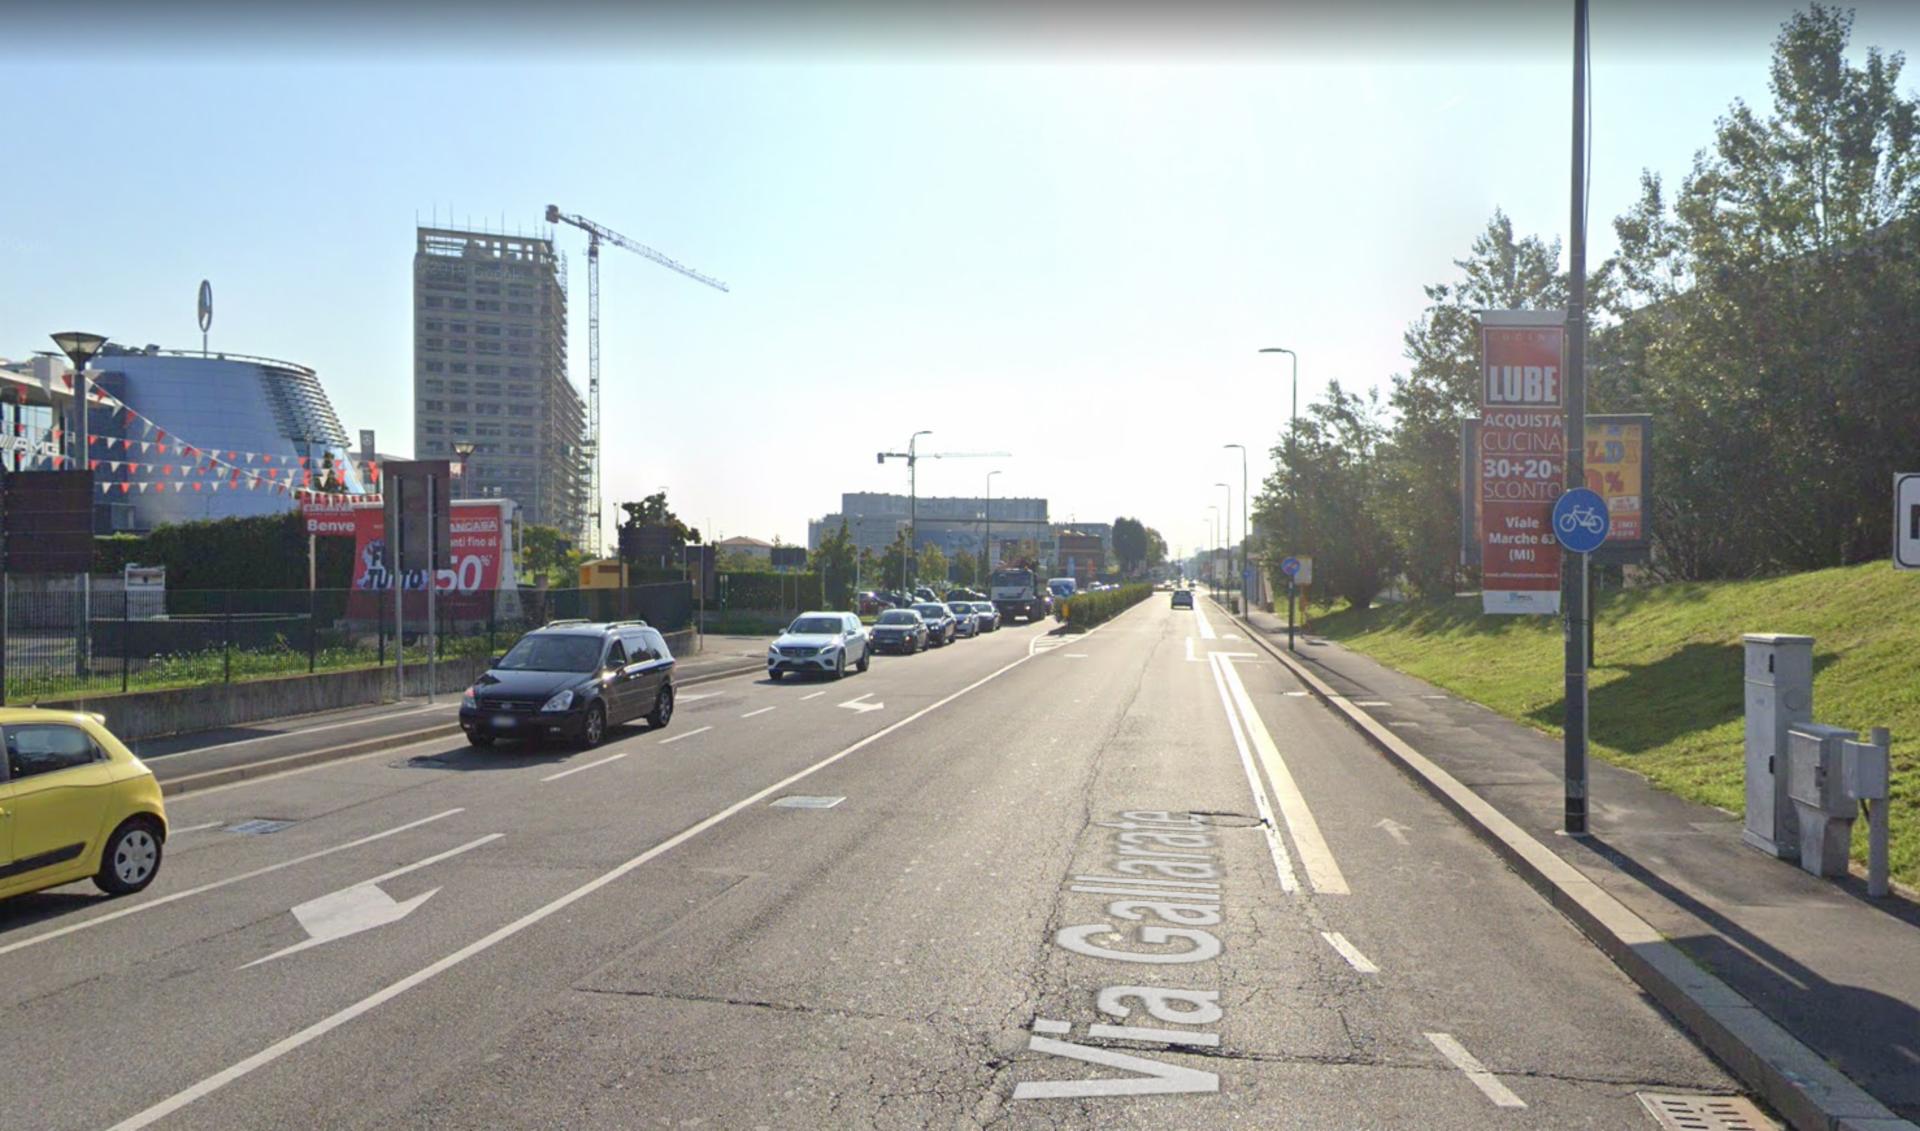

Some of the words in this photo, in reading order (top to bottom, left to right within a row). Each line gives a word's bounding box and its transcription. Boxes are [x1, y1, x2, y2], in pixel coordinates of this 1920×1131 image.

[1489, 365, 1558, 402] LUBE
[1483, 413, 1562, 430] ACQUISTA
[1482, 431, 1562, 451] CUCINA
[1483, 480, 1562, 499] SCONTO
[1504, 516, 1540, 529] Viale
[1488, 532, 1538, 545] Marche
[1540, 533, 1557, 545] 63
[1508, 548, 1536, 563] (MI)
[1055, 810, 1223, 964] Gallarate
[1012, 985, 1224, 1100] Via
